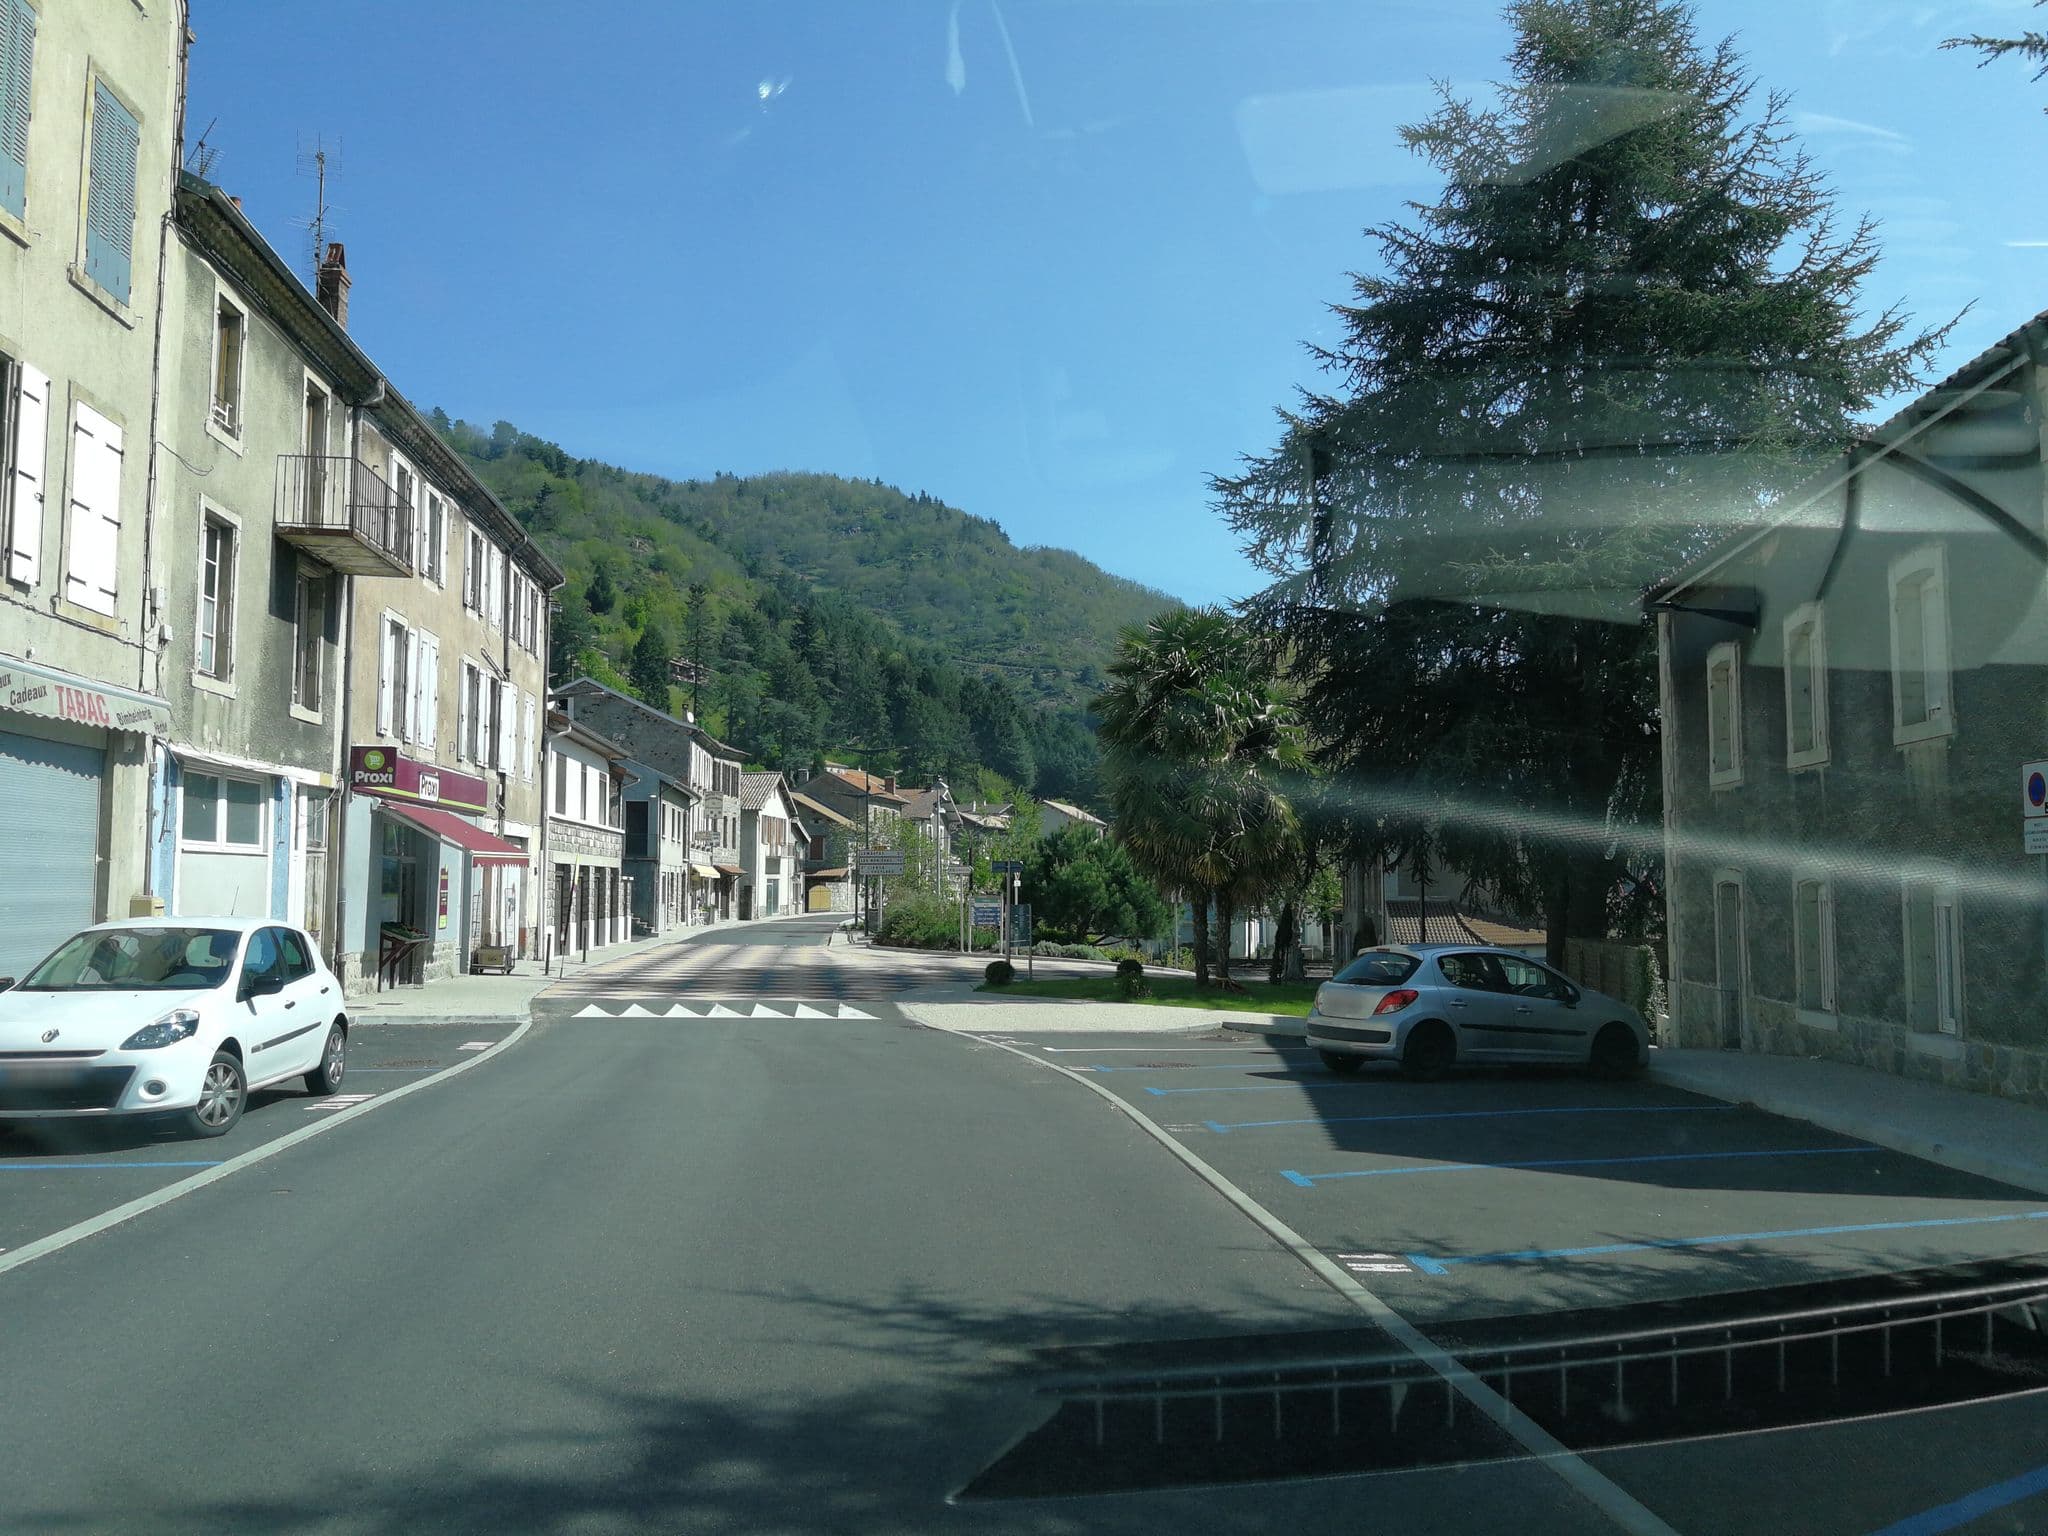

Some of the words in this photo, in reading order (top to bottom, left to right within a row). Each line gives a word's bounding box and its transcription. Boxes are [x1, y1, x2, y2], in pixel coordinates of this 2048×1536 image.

[10, 685, 48, 705] Cadeaux
[54, 685, 110, 725] TABAC
[354, 767, 394, 783] Proxi
[421, 774, 438, 797] Proxi
